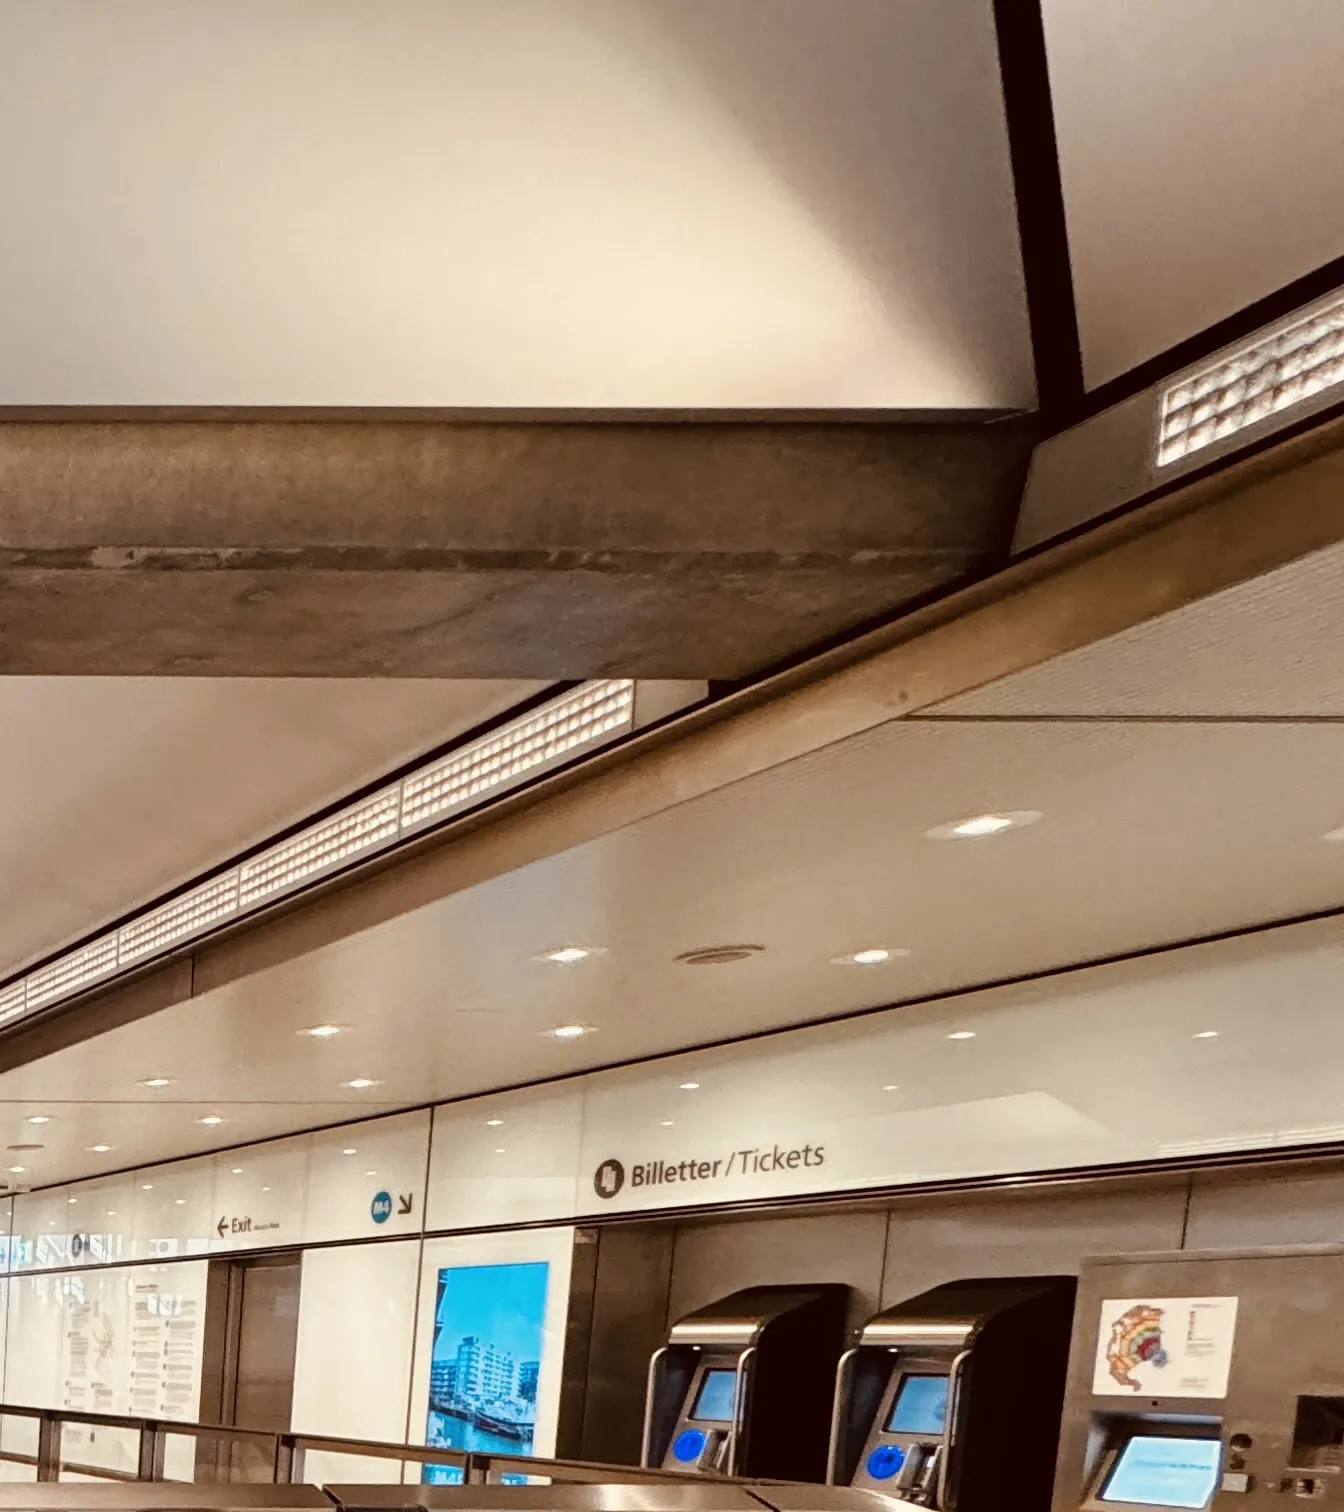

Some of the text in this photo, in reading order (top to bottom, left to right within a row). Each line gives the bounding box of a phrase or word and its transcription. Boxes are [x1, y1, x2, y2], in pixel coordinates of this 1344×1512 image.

[630, 1158, 723, 1188] Billetter
[738, 1143, 825, 1174] Tickets
[372, 1200, 390, 1215] M4
[231, 1216, 252, 1233] Exit
